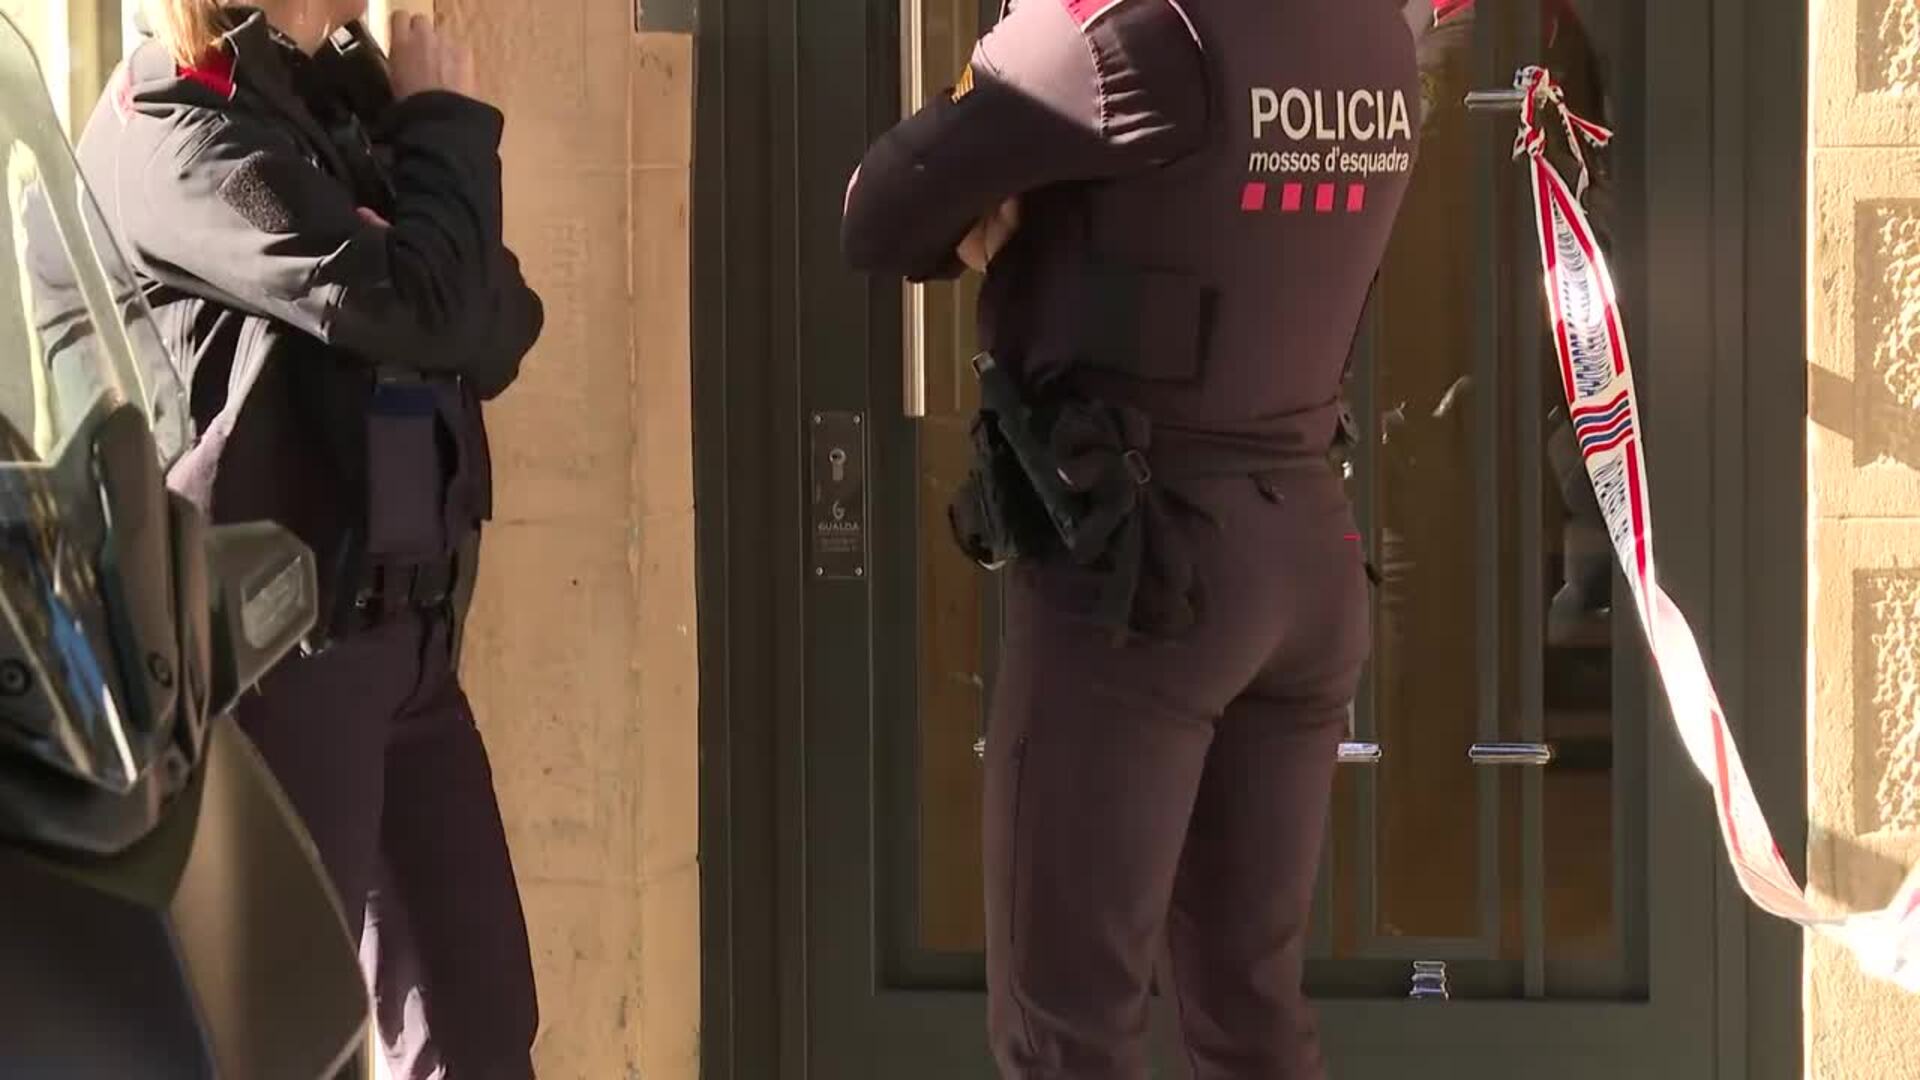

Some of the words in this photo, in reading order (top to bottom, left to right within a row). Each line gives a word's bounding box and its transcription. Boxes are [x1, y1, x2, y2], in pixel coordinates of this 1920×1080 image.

[1250, 87, 1411, 141] POLICIA
[1249, 151, 1320, 172] mossos
[1325, 146, 1409, 178] d'esquadra
